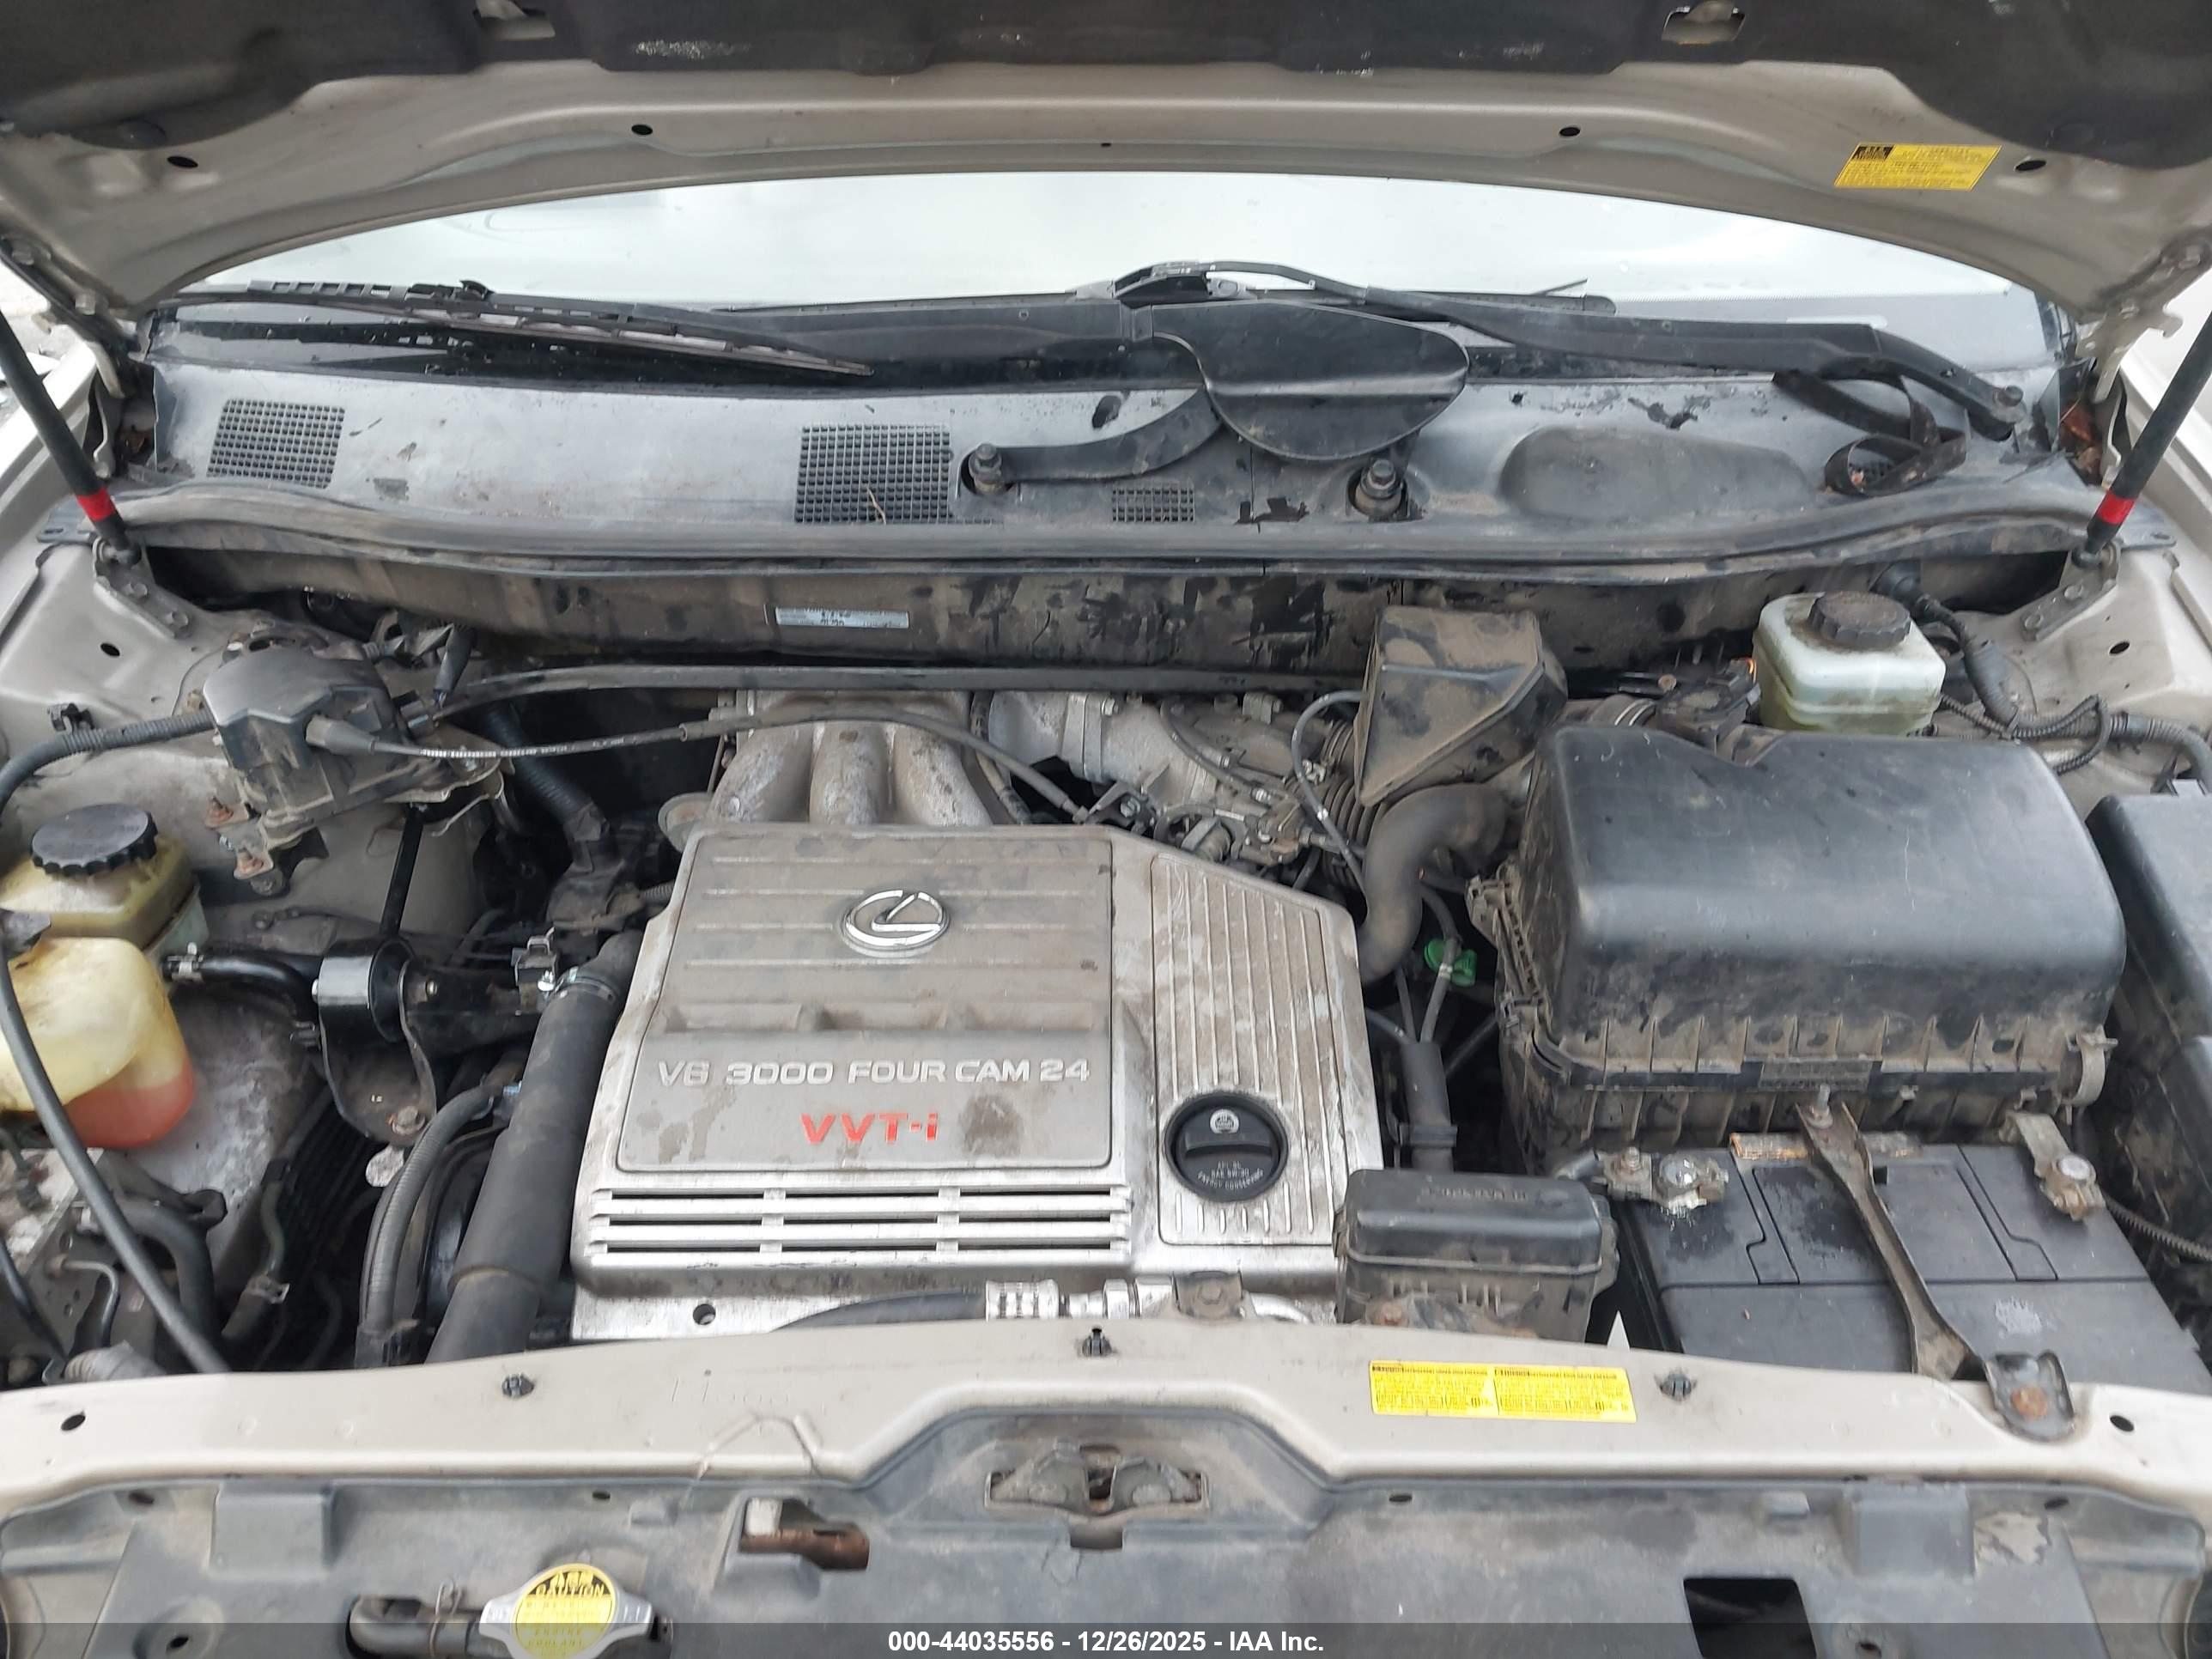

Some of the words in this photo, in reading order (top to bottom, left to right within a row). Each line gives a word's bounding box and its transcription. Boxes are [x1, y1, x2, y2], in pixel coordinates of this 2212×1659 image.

[658, 1060, 709, 1087] V6
[725, 1060, 835, 1085] 3000
[848, 1060, 946, 1085] FOUR
[954, 1059, 1030, 1083] CAM
[1039, 1058, 1091, 1082] 24
[801, 1112, 939, 1145] VVT-i
